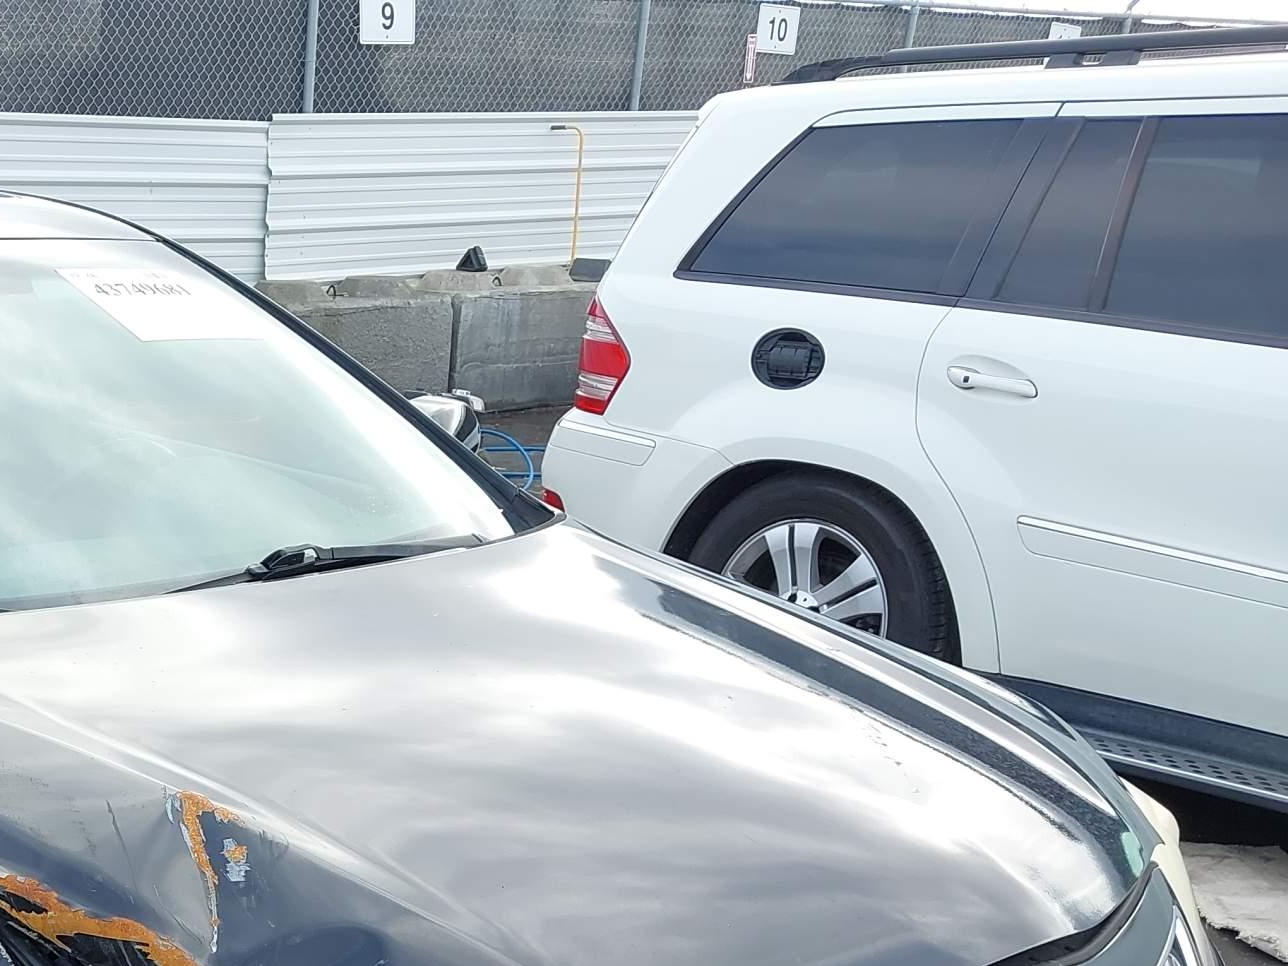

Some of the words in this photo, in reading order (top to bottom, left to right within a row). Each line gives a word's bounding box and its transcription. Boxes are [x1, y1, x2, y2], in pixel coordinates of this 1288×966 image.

[381, 1, 395, 31] 9
[768, 16, 788, 42] 10
[95, 283, 192, 296] 43749681
